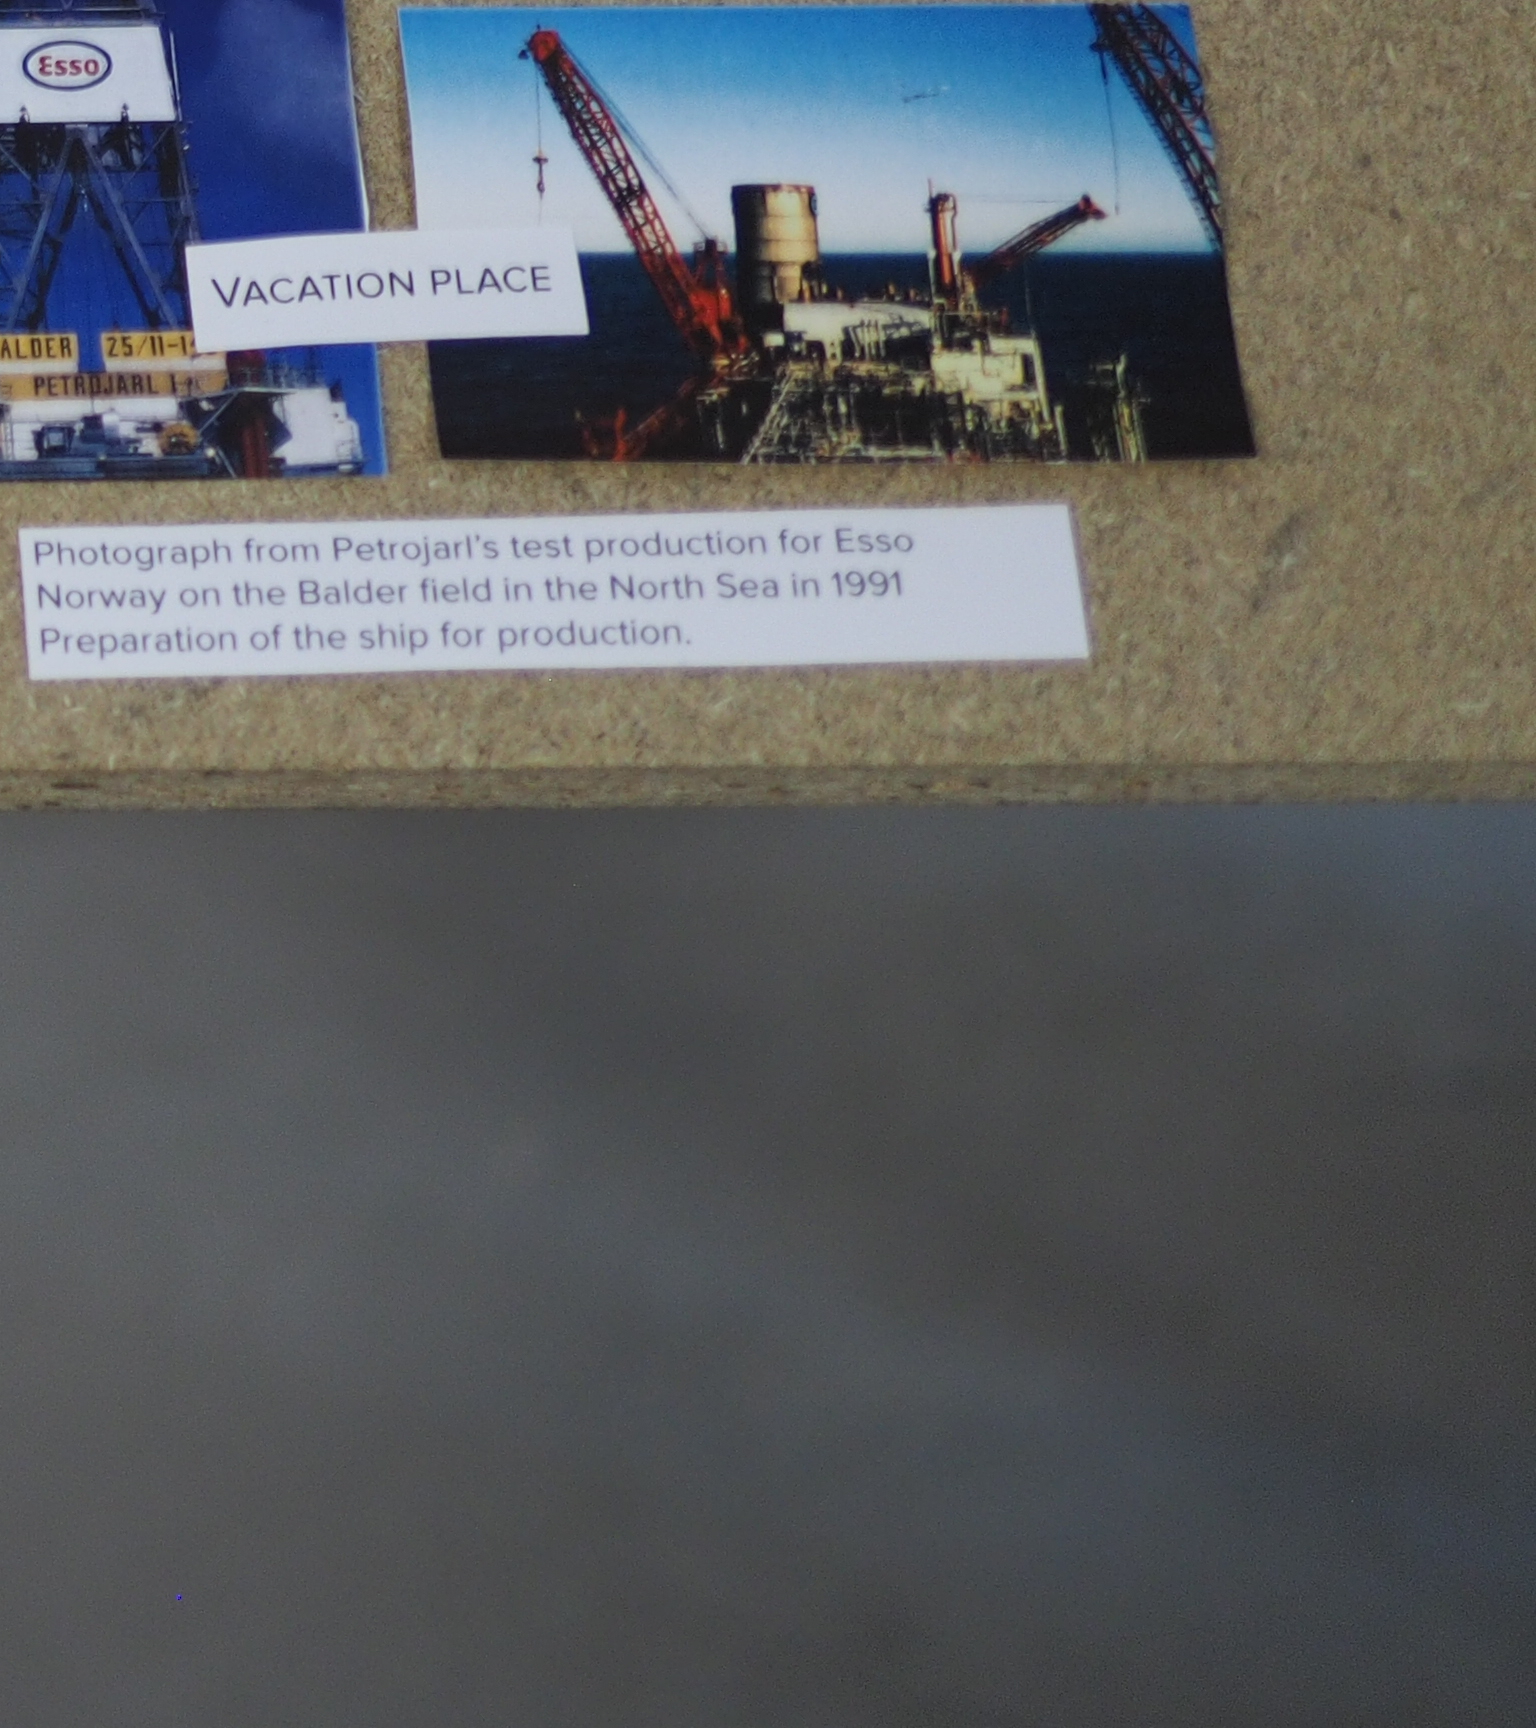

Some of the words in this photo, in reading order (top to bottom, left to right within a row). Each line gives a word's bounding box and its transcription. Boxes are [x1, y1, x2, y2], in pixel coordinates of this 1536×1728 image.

[38, 55, 101, 77] Esso
[210, 270, 415, 309] VACATION
[430, 265, 552, 296] PLACE
[106, 335, 196, 357] 25/11-1
[33, 375, 160, 396] PETROJARL
[33, 538, 233, 572] Photograph
[243, 536, 321, 563] from
[331, 533, 500, 568] Petrojarl's
[509, 534, 574, 560] test
[584, 530, 768, 565] production
[777, 527, 822, 555] for
[834, 526, 915, 554] Esso
[36, 582, 167, 615] Norway
[178, 586, 222, 609] on
[231, 580, 287, 607] the
[297, 578, 408, 606] Balder
[419, 576, 493, 604] field
[503, 576, 533, 602] in
[543, 575, 599, 602] the
[608, 573, 705, 601] North
[715, 571, 780, 600] Sea
[791, 572, 821, 598] in
[830, 569, 903, 598] 1991
[39, 626, 238, 661] Preparation
[248, 622, 283, 652] of
[292, 623, 348, 652] the
[358, 622, 430, 656] ship
[439, 619, 485, 649] for
[497, 619, 692, 655] production.
